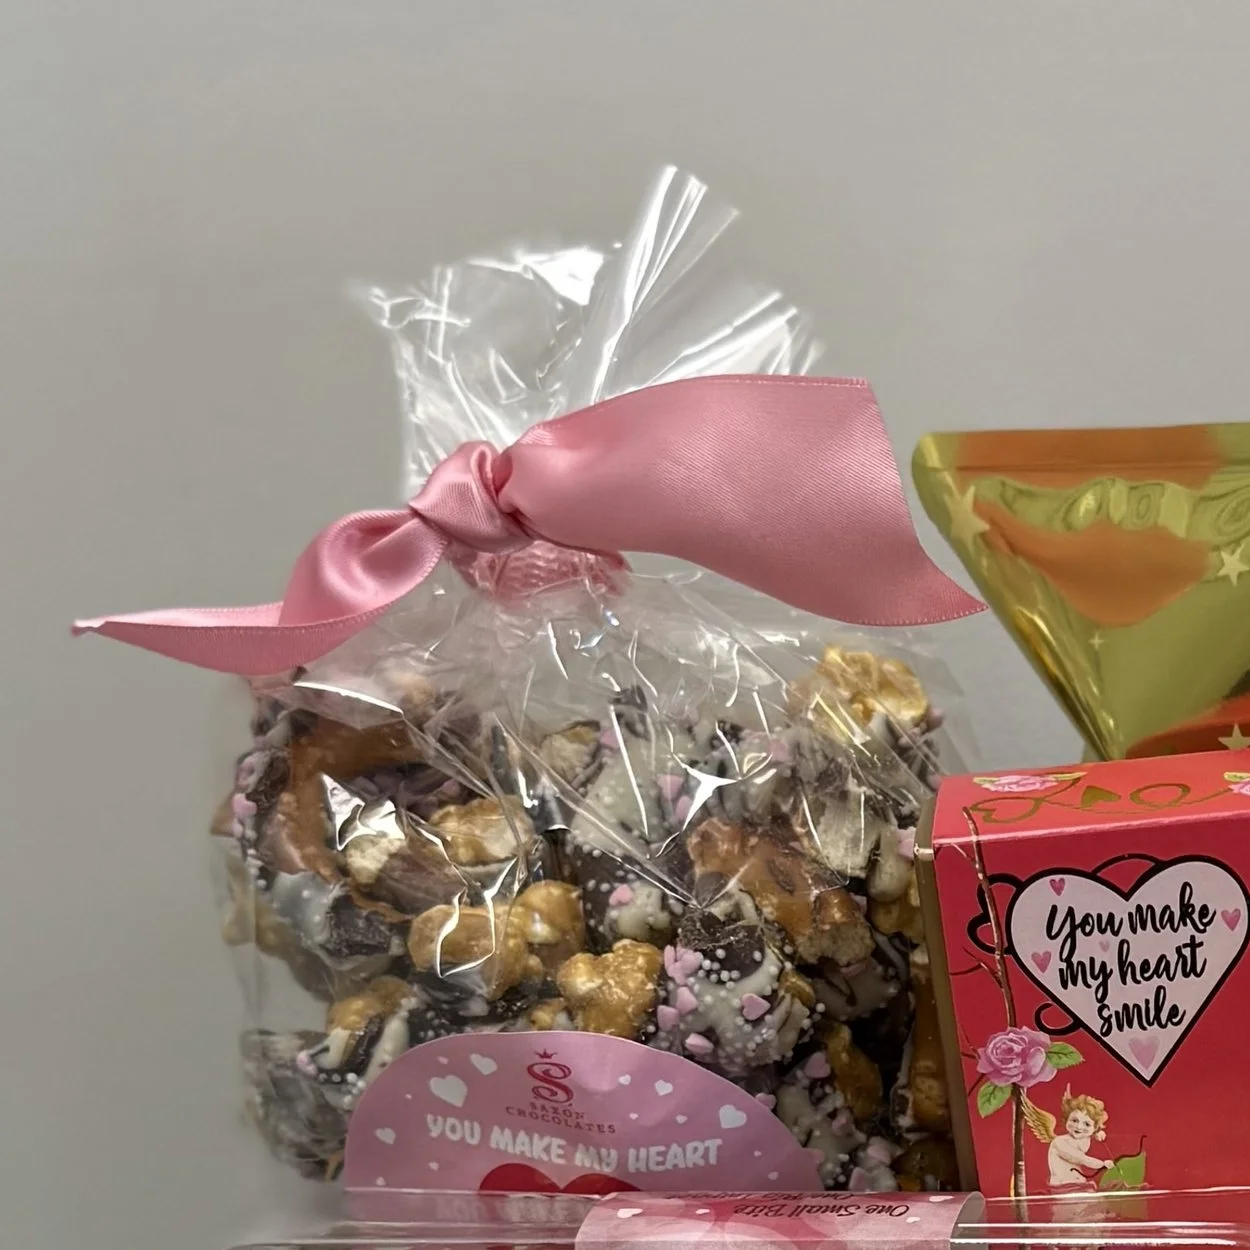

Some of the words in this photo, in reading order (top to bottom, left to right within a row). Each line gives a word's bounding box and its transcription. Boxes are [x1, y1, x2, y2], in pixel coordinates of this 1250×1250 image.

[1045, 904, 1124, 963] You
[1127, 881, 1217, 934] make
[1058, 956, 1113, 1004] my
[1117, 934, 1208, 985] heart
[1097, 984, 1187, 1038] smile
[505, 1106, 616, 1134] CHOCOLATES
[425, 1114, 481, 1146] YOU
[489, 1124, 567, 1164] MAKE
[573, 1142, 618, 1173] MY
[627, 1138, 723, 1174] HEART
[733, 1203, 788, 1218] Bite
[788, 1203, 861, 1218] Small
[865, 1203, 910, 1218] One
